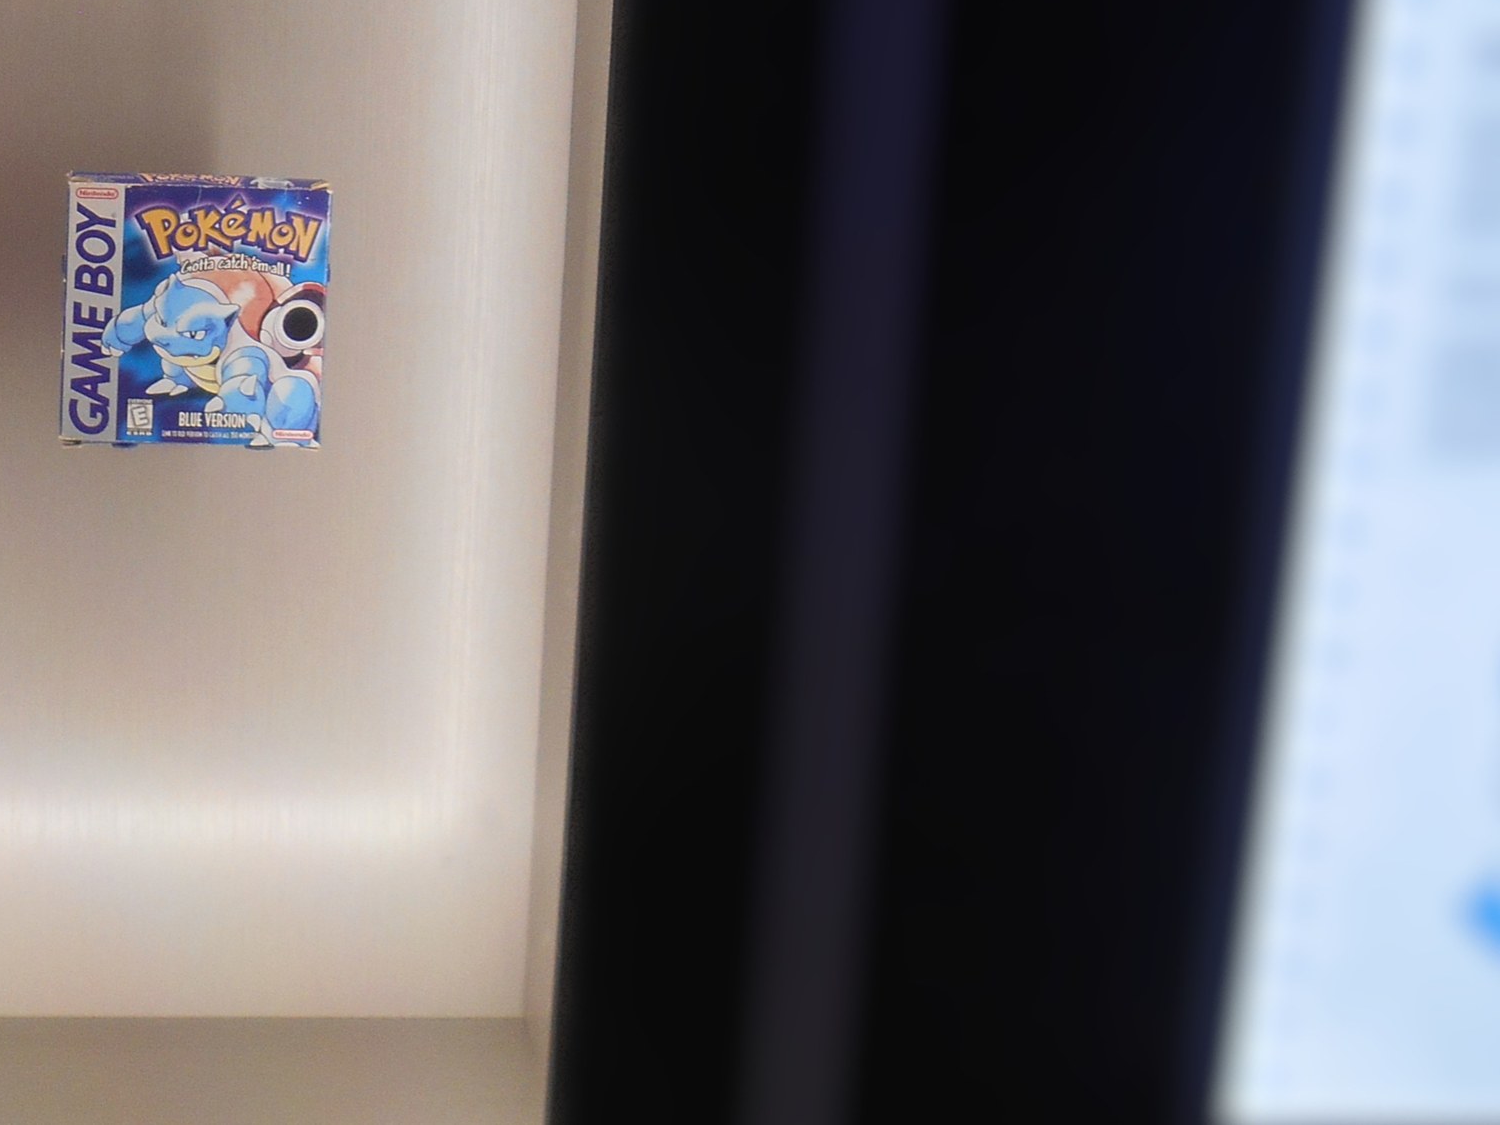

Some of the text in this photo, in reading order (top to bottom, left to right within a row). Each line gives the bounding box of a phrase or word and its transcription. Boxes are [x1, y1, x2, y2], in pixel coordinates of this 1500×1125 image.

[75, 202, 117, 297] BOY
[181, 258, 214, 274] Gotta
[217, 253, 248, 270] catch
[68, 301, 113, 435] GAME
[130, 405, 150, 426] E
[178, 412, 246, 428] BLUE VERSION
